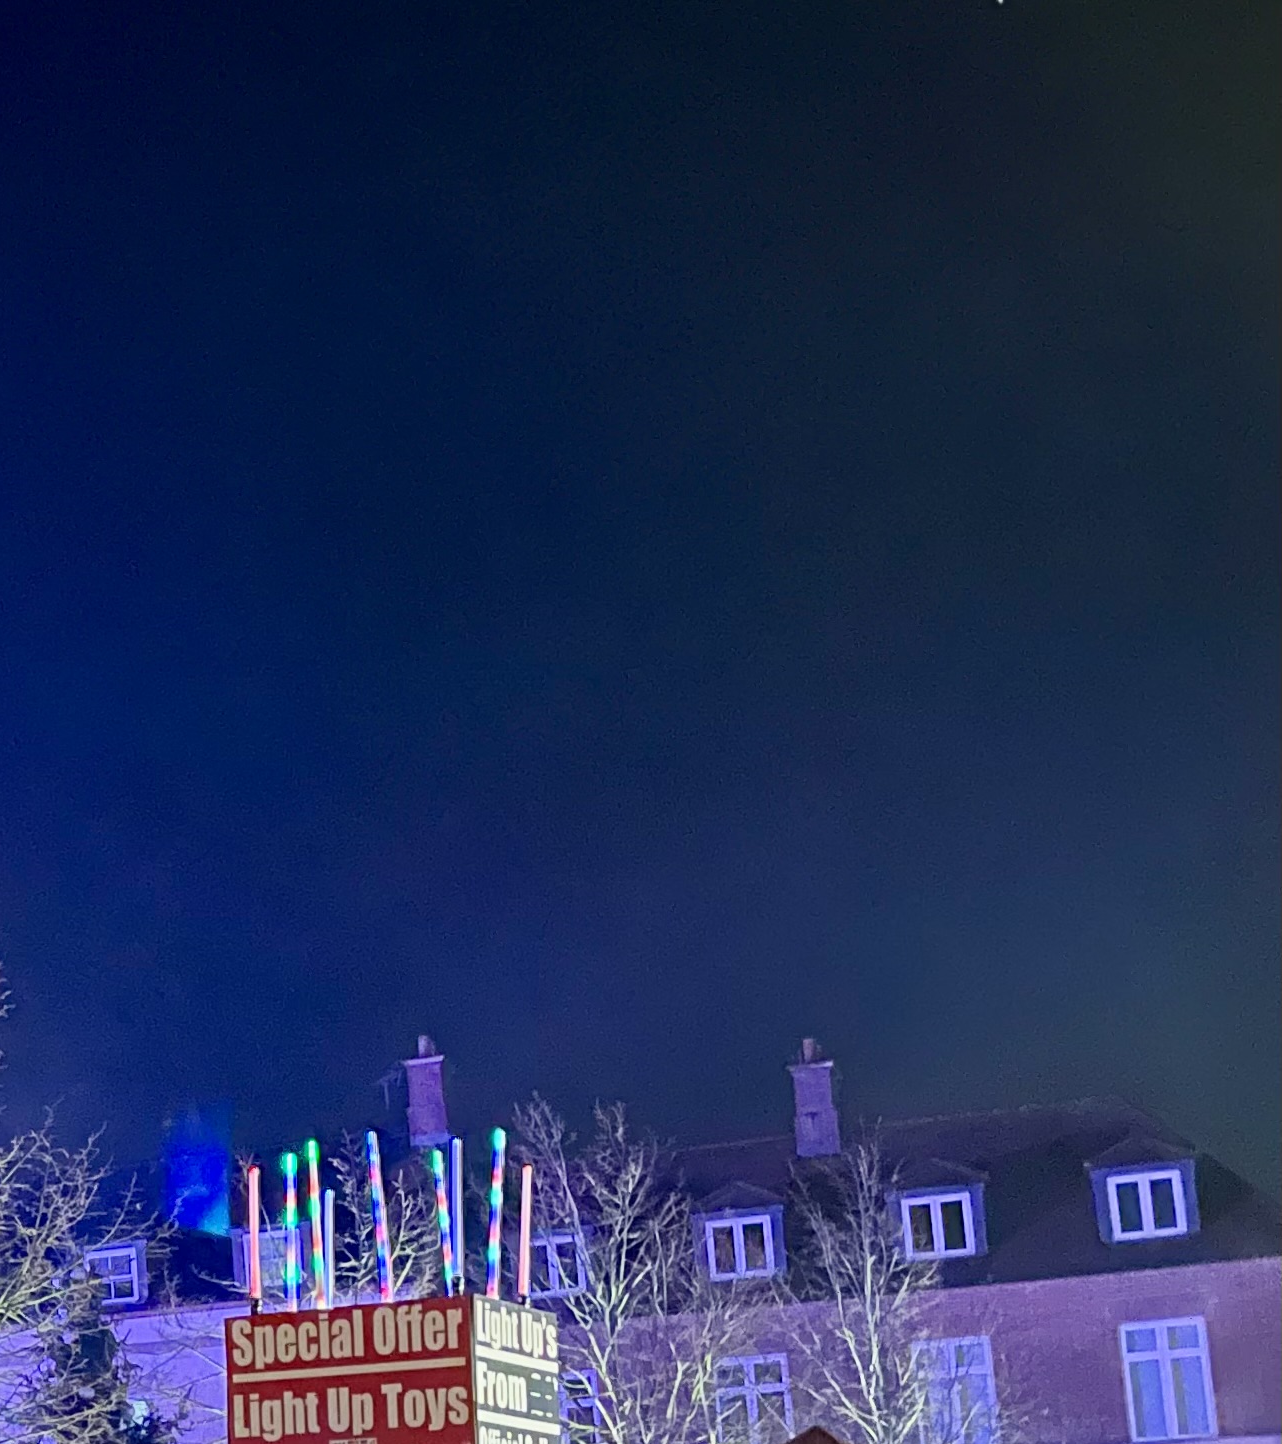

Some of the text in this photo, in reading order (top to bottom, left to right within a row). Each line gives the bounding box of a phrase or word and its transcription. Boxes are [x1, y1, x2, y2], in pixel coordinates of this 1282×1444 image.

[232, 1304, 463, 1369] Special Offer
[476, 1300, 558, 1358] Light Up's
[233, 1382, 469, 1442] Light Up Toys
[476, 1360, 527, 1413] From
